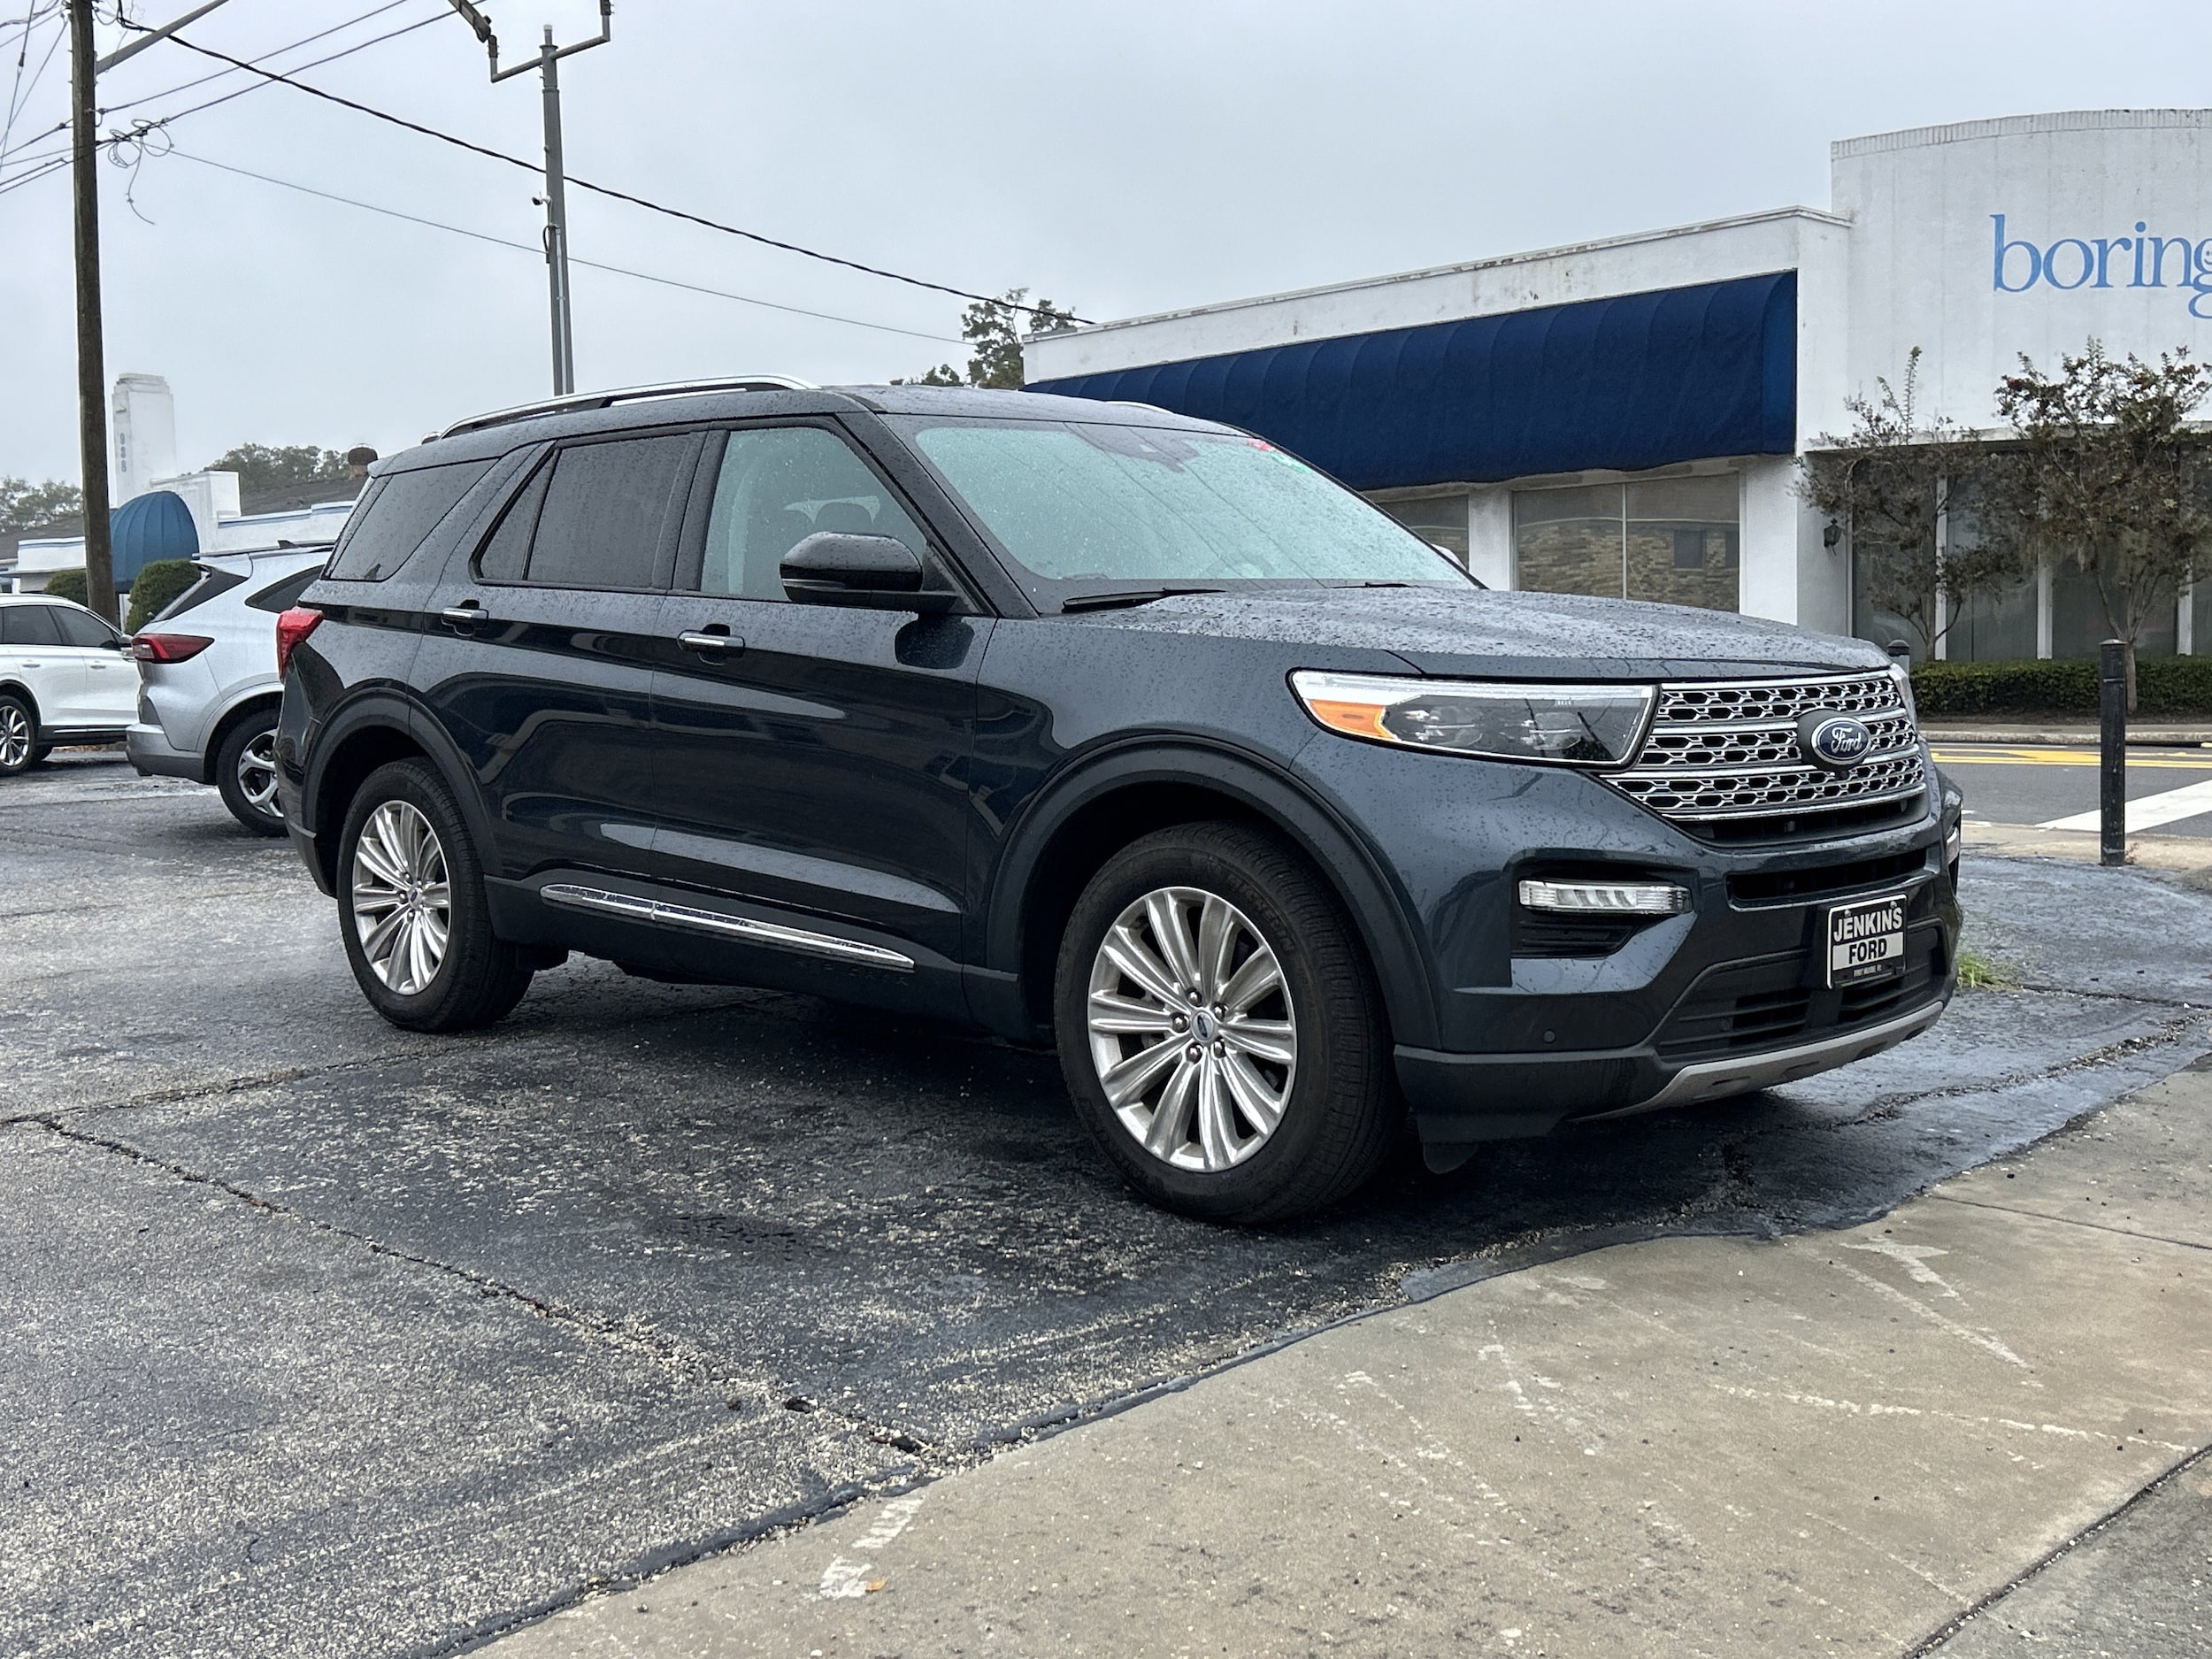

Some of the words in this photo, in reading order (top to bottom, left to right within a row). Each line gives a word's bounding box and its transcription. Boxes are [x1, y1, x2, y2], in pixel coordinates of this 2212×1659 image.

[1831, 726, 1862, 753] Ford
[1833, 907, 1902, 942] JENKINS
[1848, 938, 1887, 964] FORD
